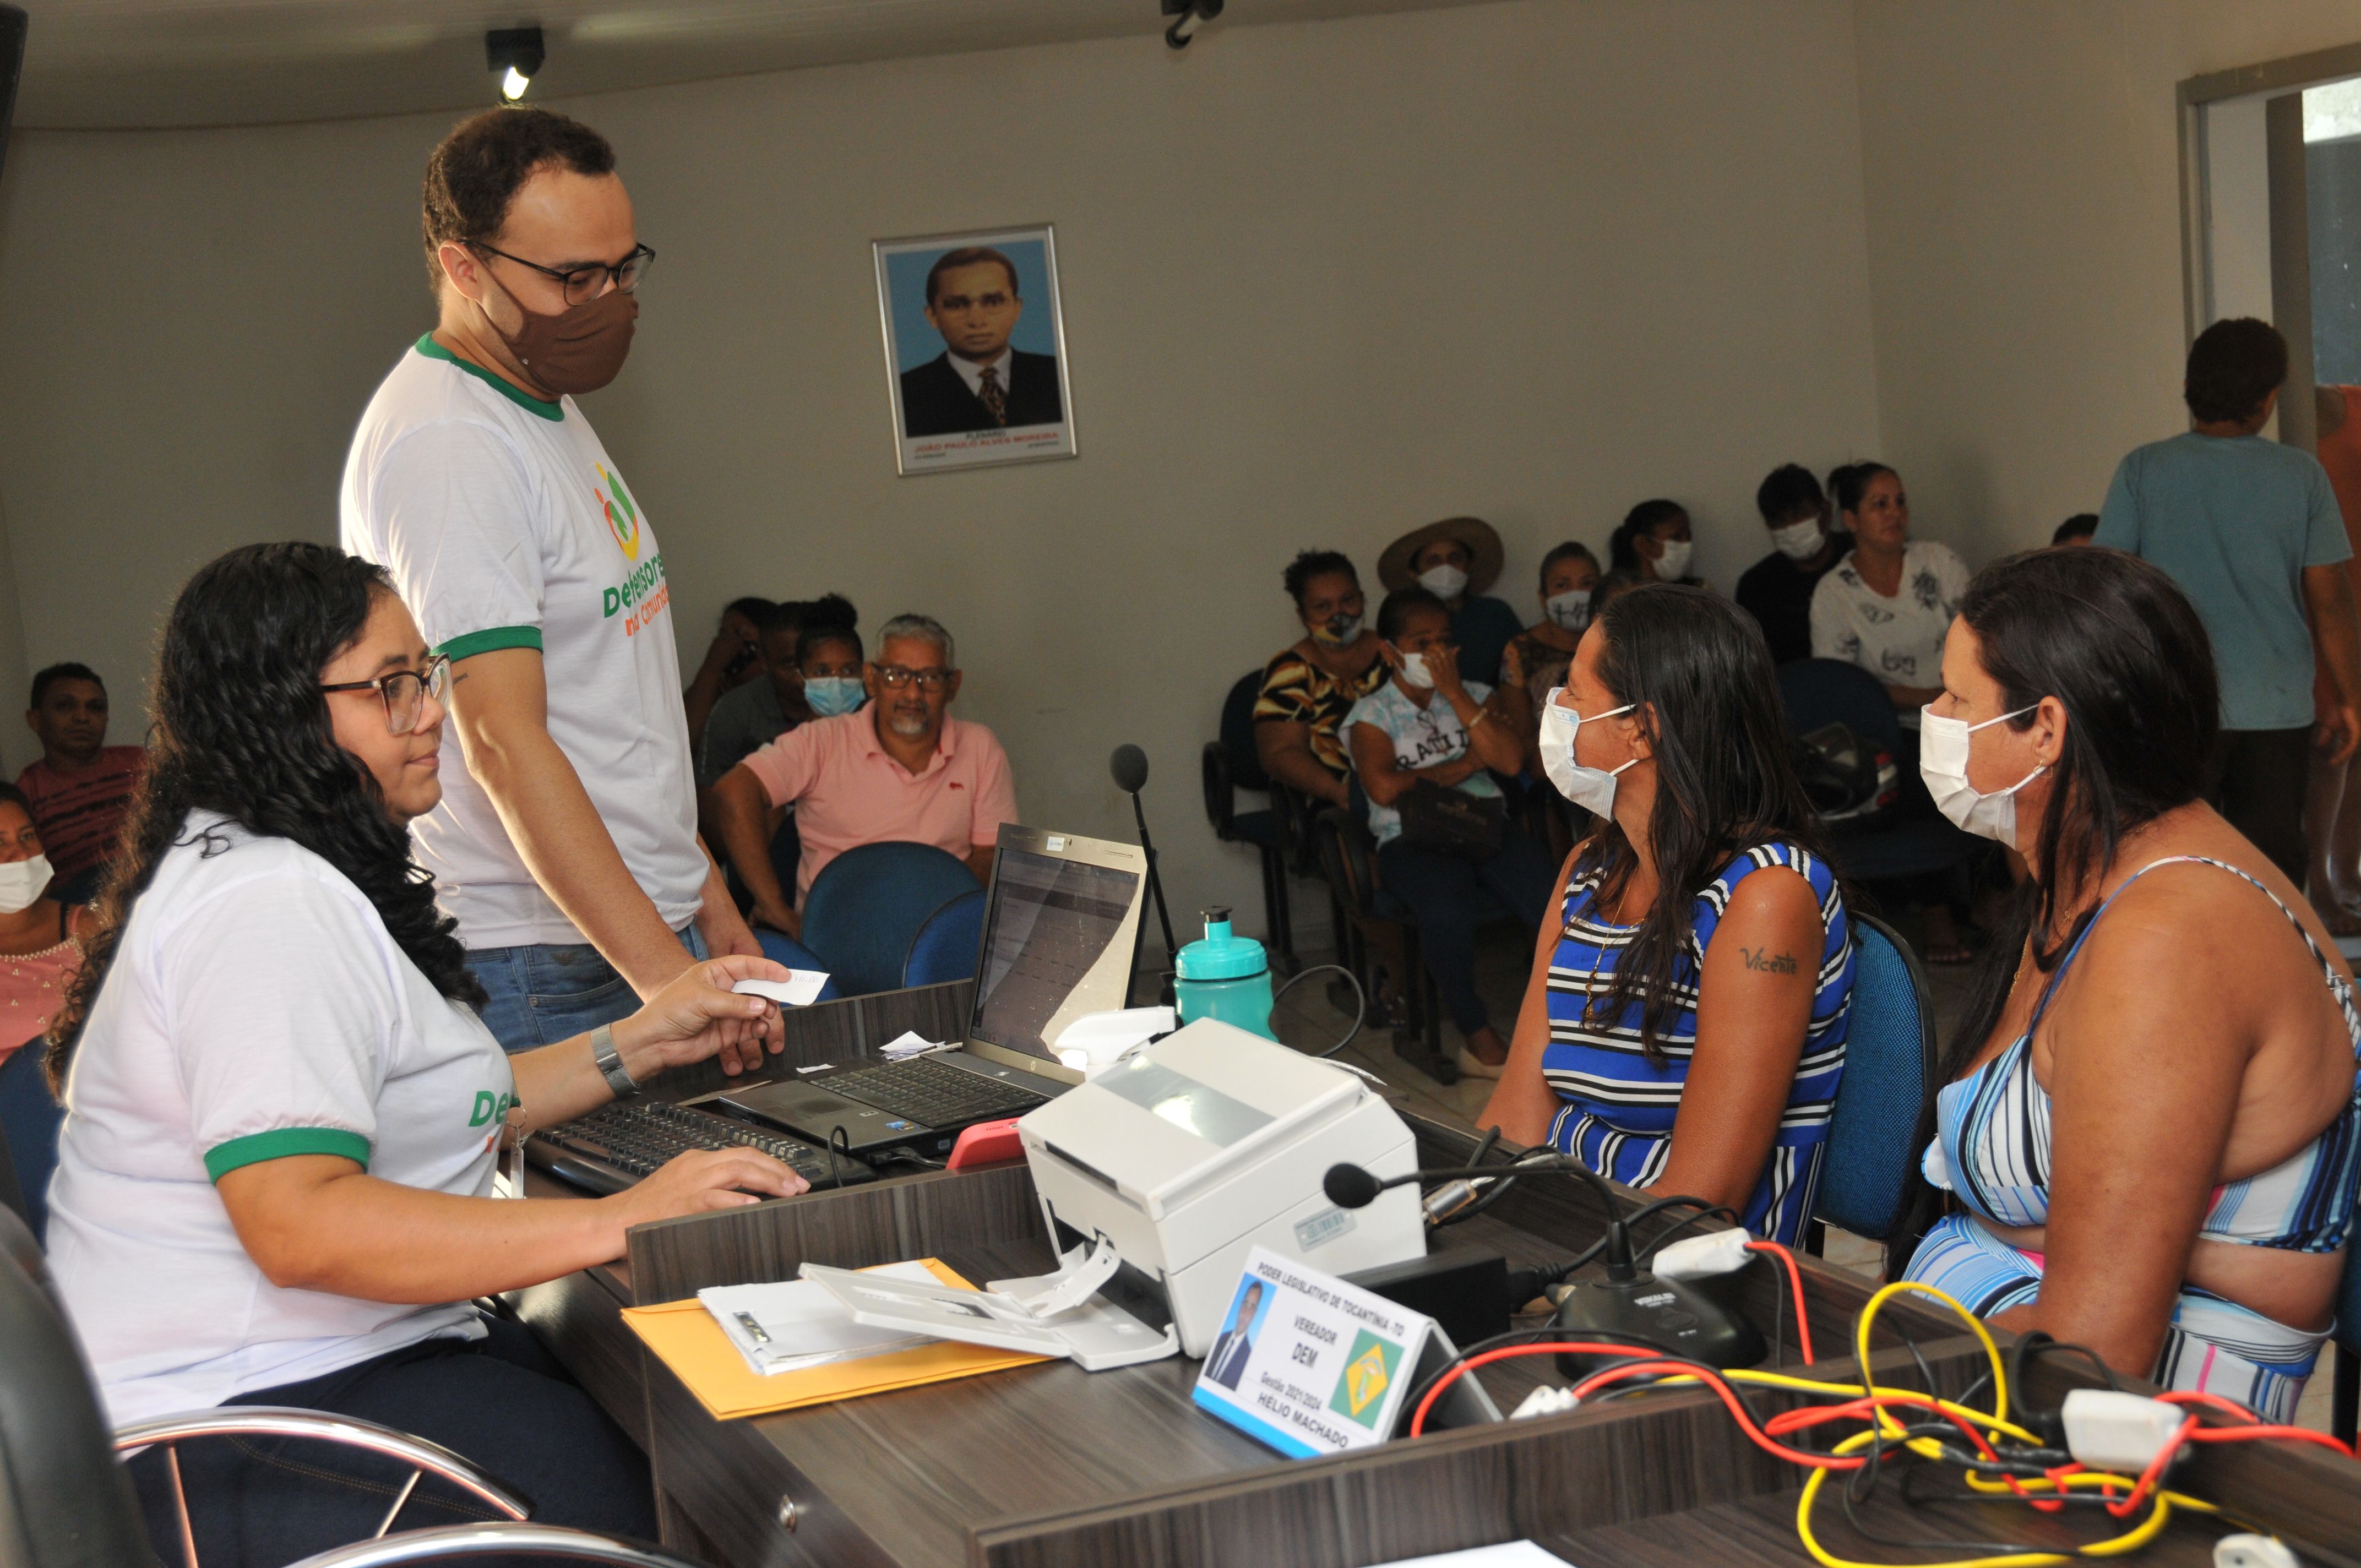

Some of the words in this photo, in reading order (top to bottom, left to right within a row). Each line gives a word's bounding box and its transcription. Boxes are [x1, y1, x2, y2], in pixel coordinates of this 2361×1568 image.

[945, 441, 976, 449] PAULO
[625, 612, 640, 636] na
[1257, 1262, 1282, 1283] PODER
[1282, 1273, 1330, 1303] LEGISLATIVO
[1330, 1294, 1340, 1308] DE
[1294, 1315, 1337, 1345] VEREADOR
[1292, 1342, 1319, 1368] DEM
[1292, 1410, 1348, 1447] MACHADO
